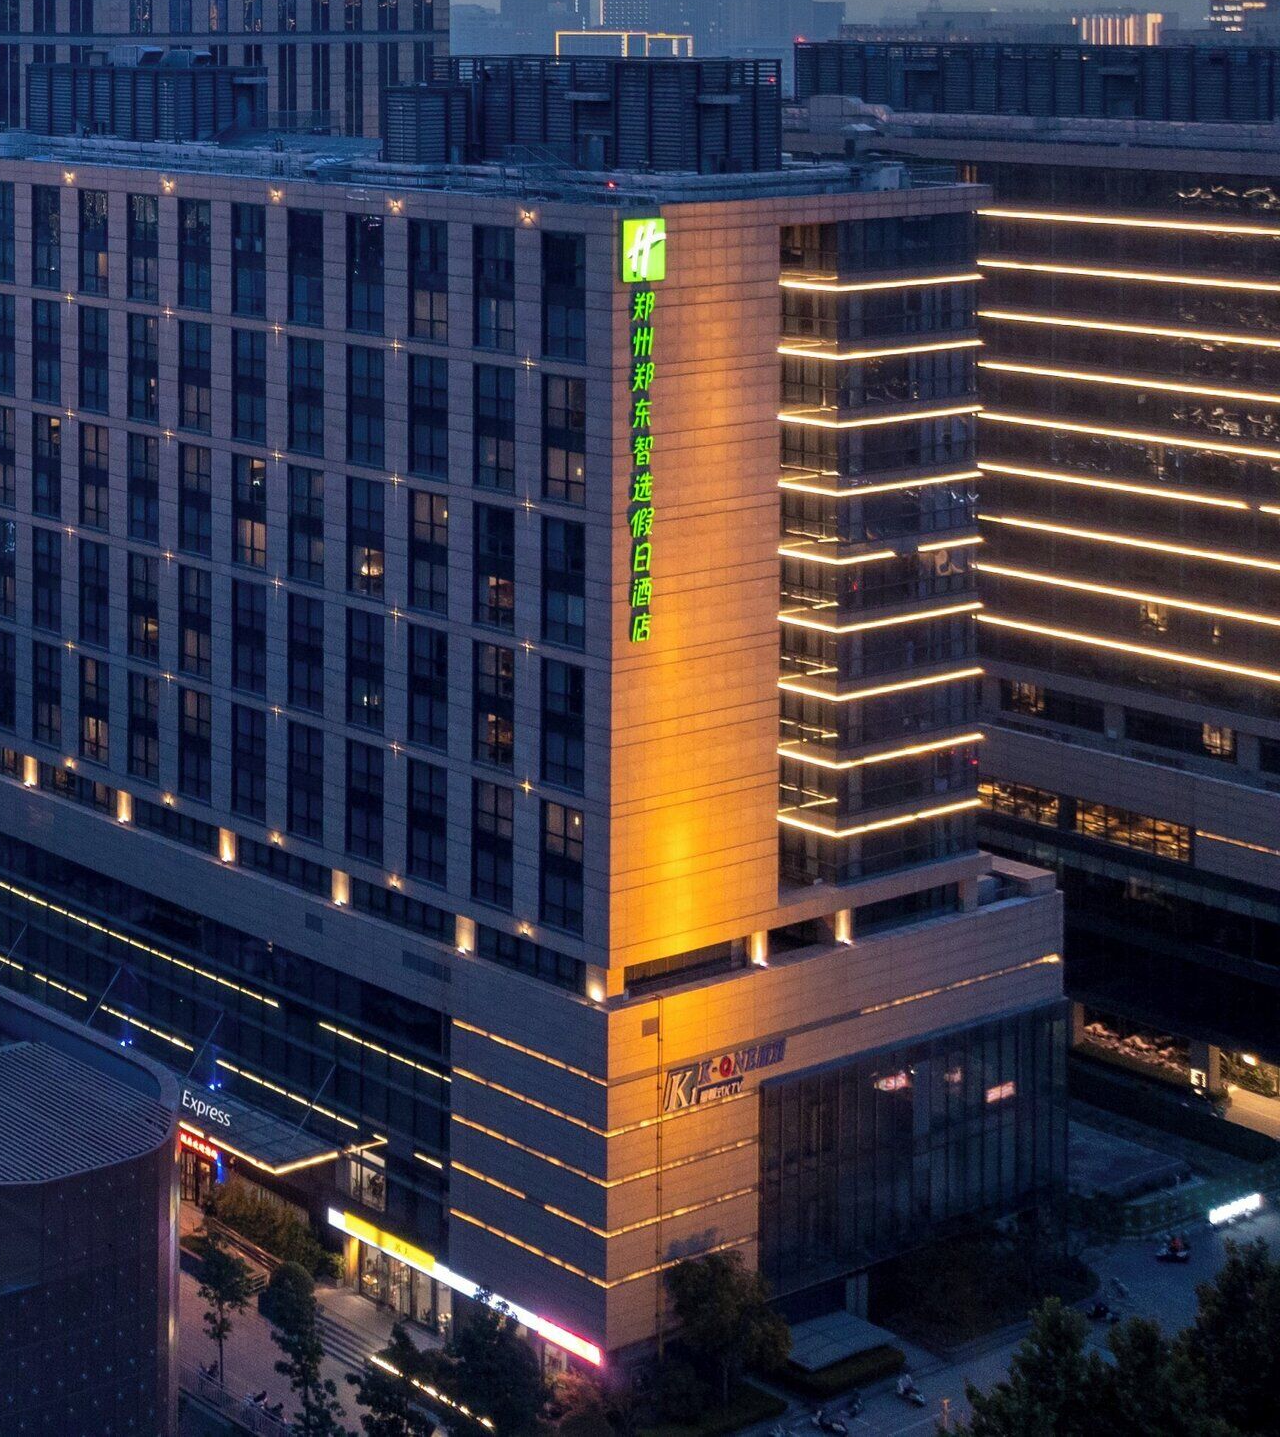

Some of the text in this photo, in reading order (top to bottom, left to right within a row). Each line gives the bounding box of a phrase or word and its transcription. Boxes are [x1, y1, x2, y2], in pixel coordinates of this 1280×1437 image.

[630, 291, 655, 644] 郑州郑东智选假日酒店
[182, 1089, 232, 1127] Express
